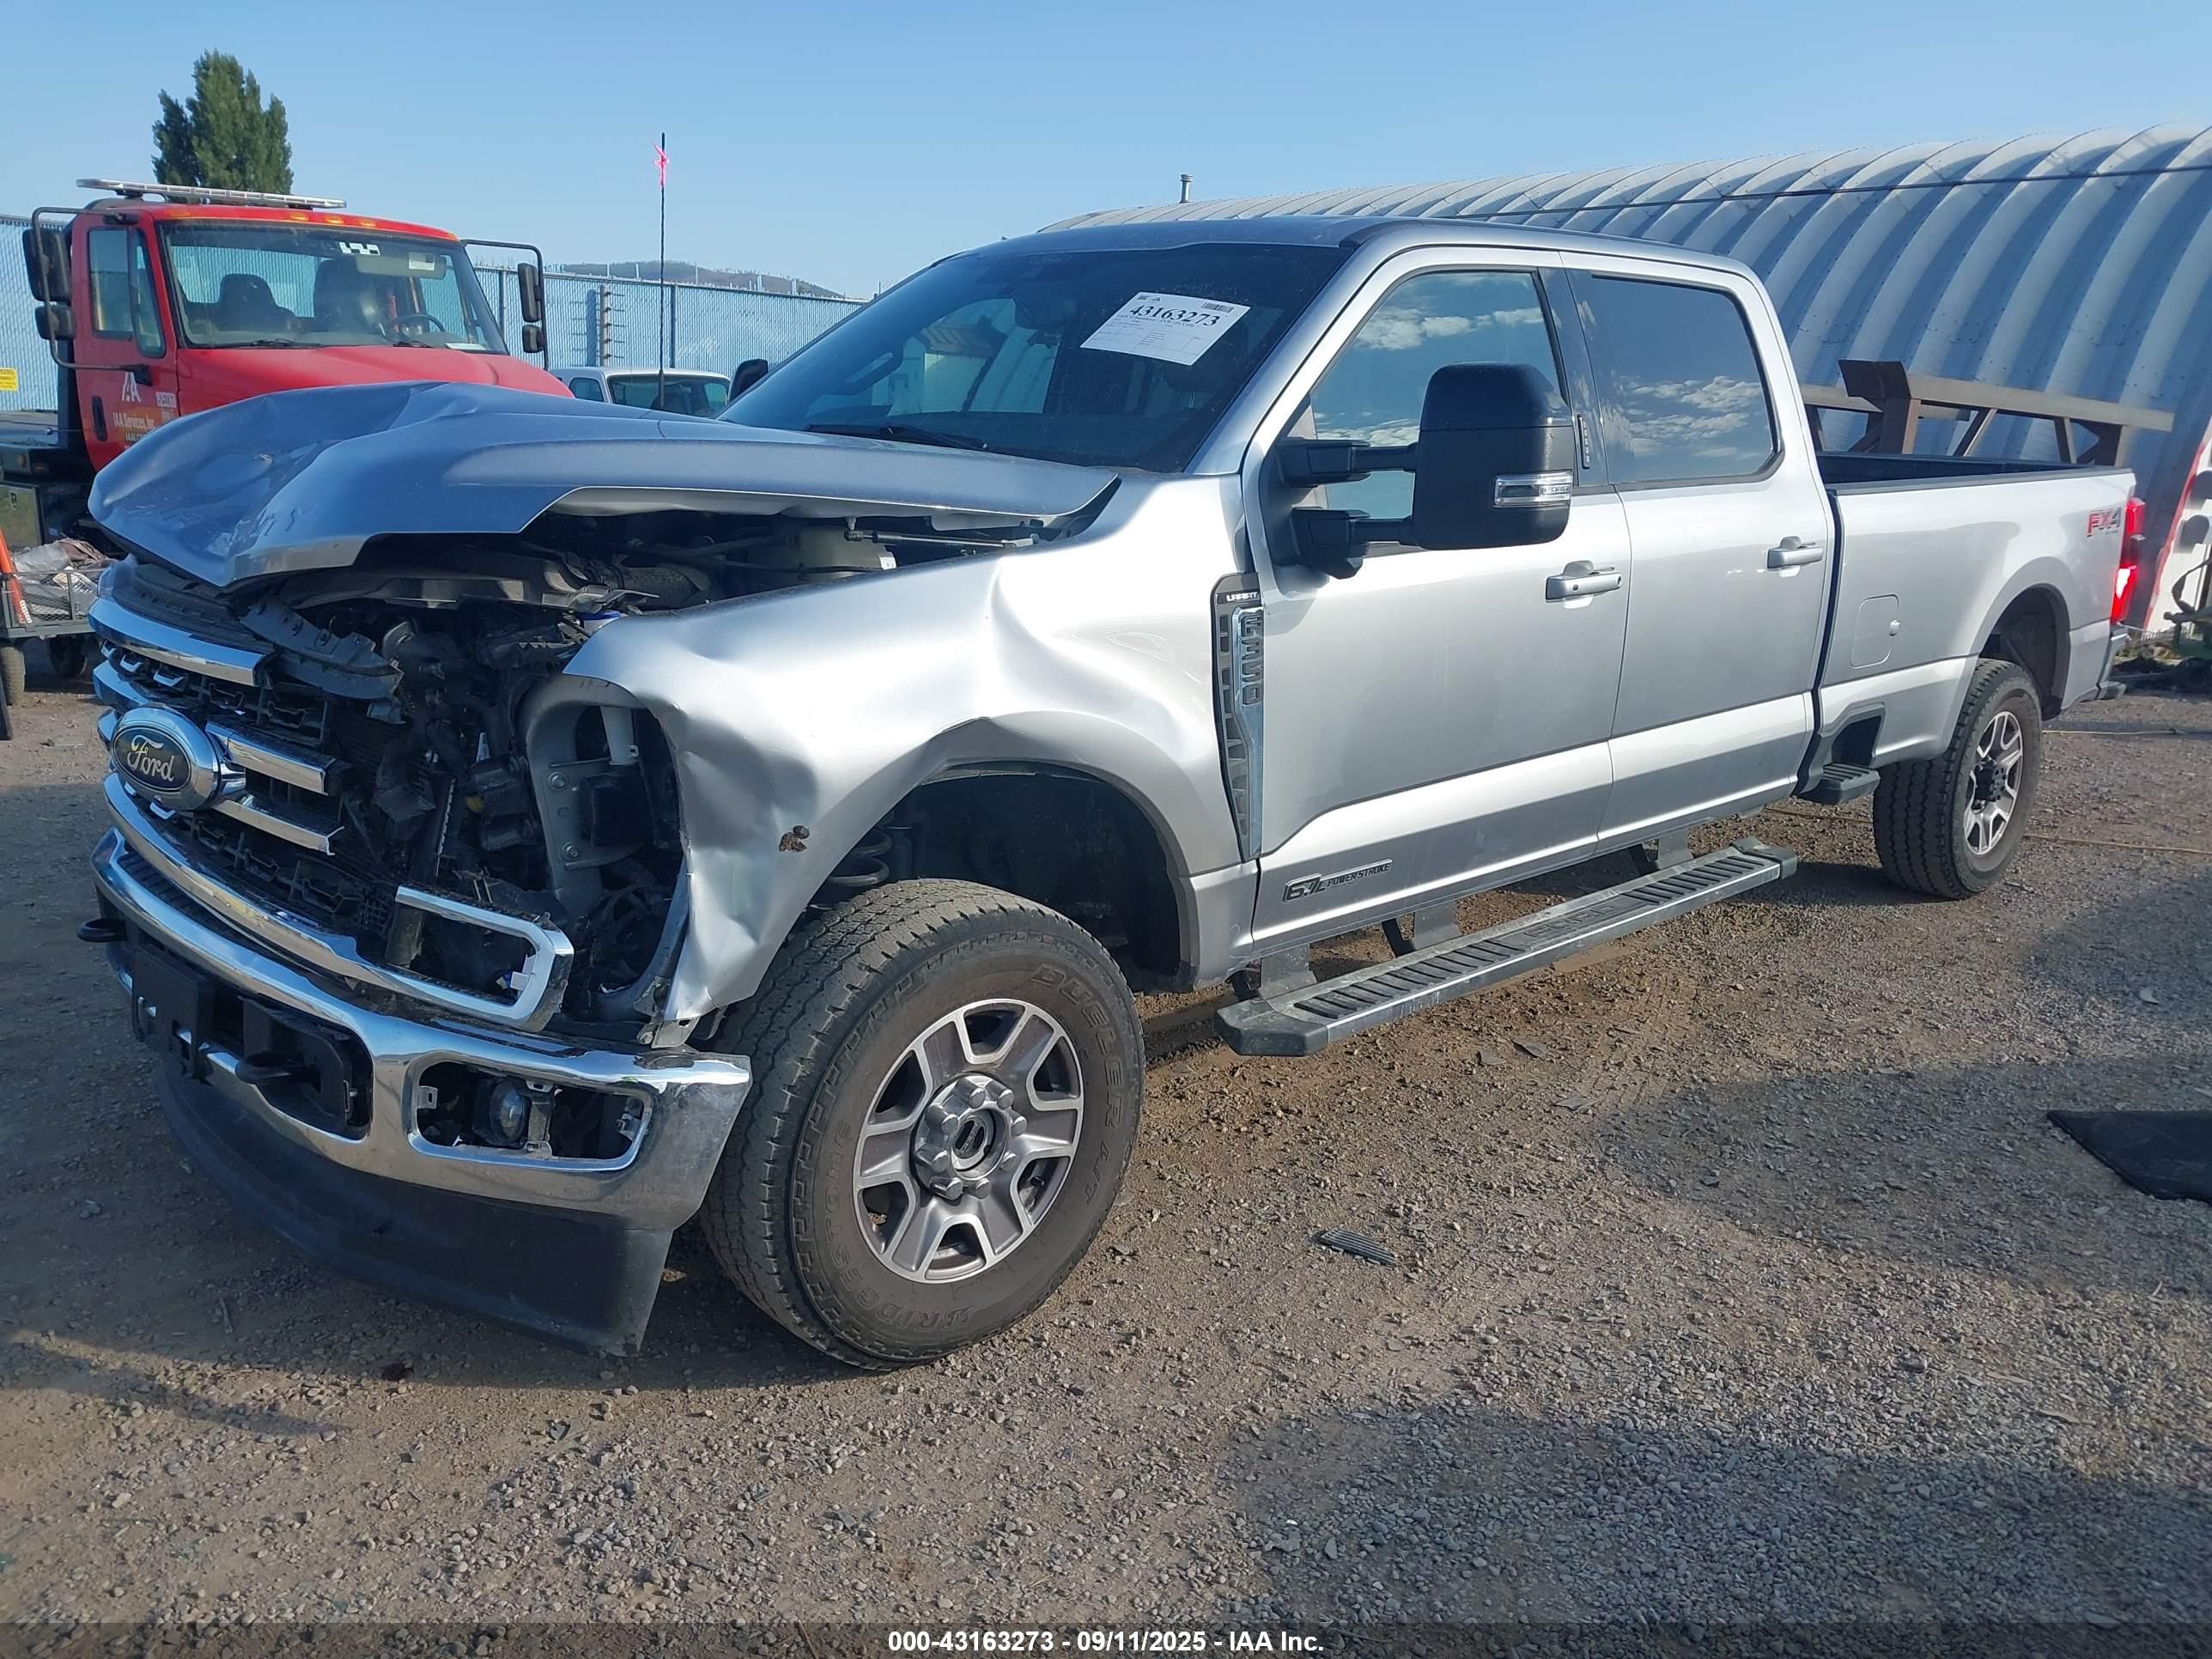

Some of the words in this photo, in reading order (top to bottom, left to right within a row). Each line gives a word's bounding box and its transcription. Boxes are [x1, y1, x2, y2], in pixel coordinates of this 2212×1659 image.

[1129, 304, 1220, 326] 43163273
[2087, 507, 2122, 537] FX4
[1226, 591, 1258, 602] LARIAT
[126, 734, 175, 782] Ford
[1283, 876, 1327, 902] 6.7L
[1029, 963, 1122, 1129] DUELER
[822, 1121, 975, 1332] BRIDGESTONE
